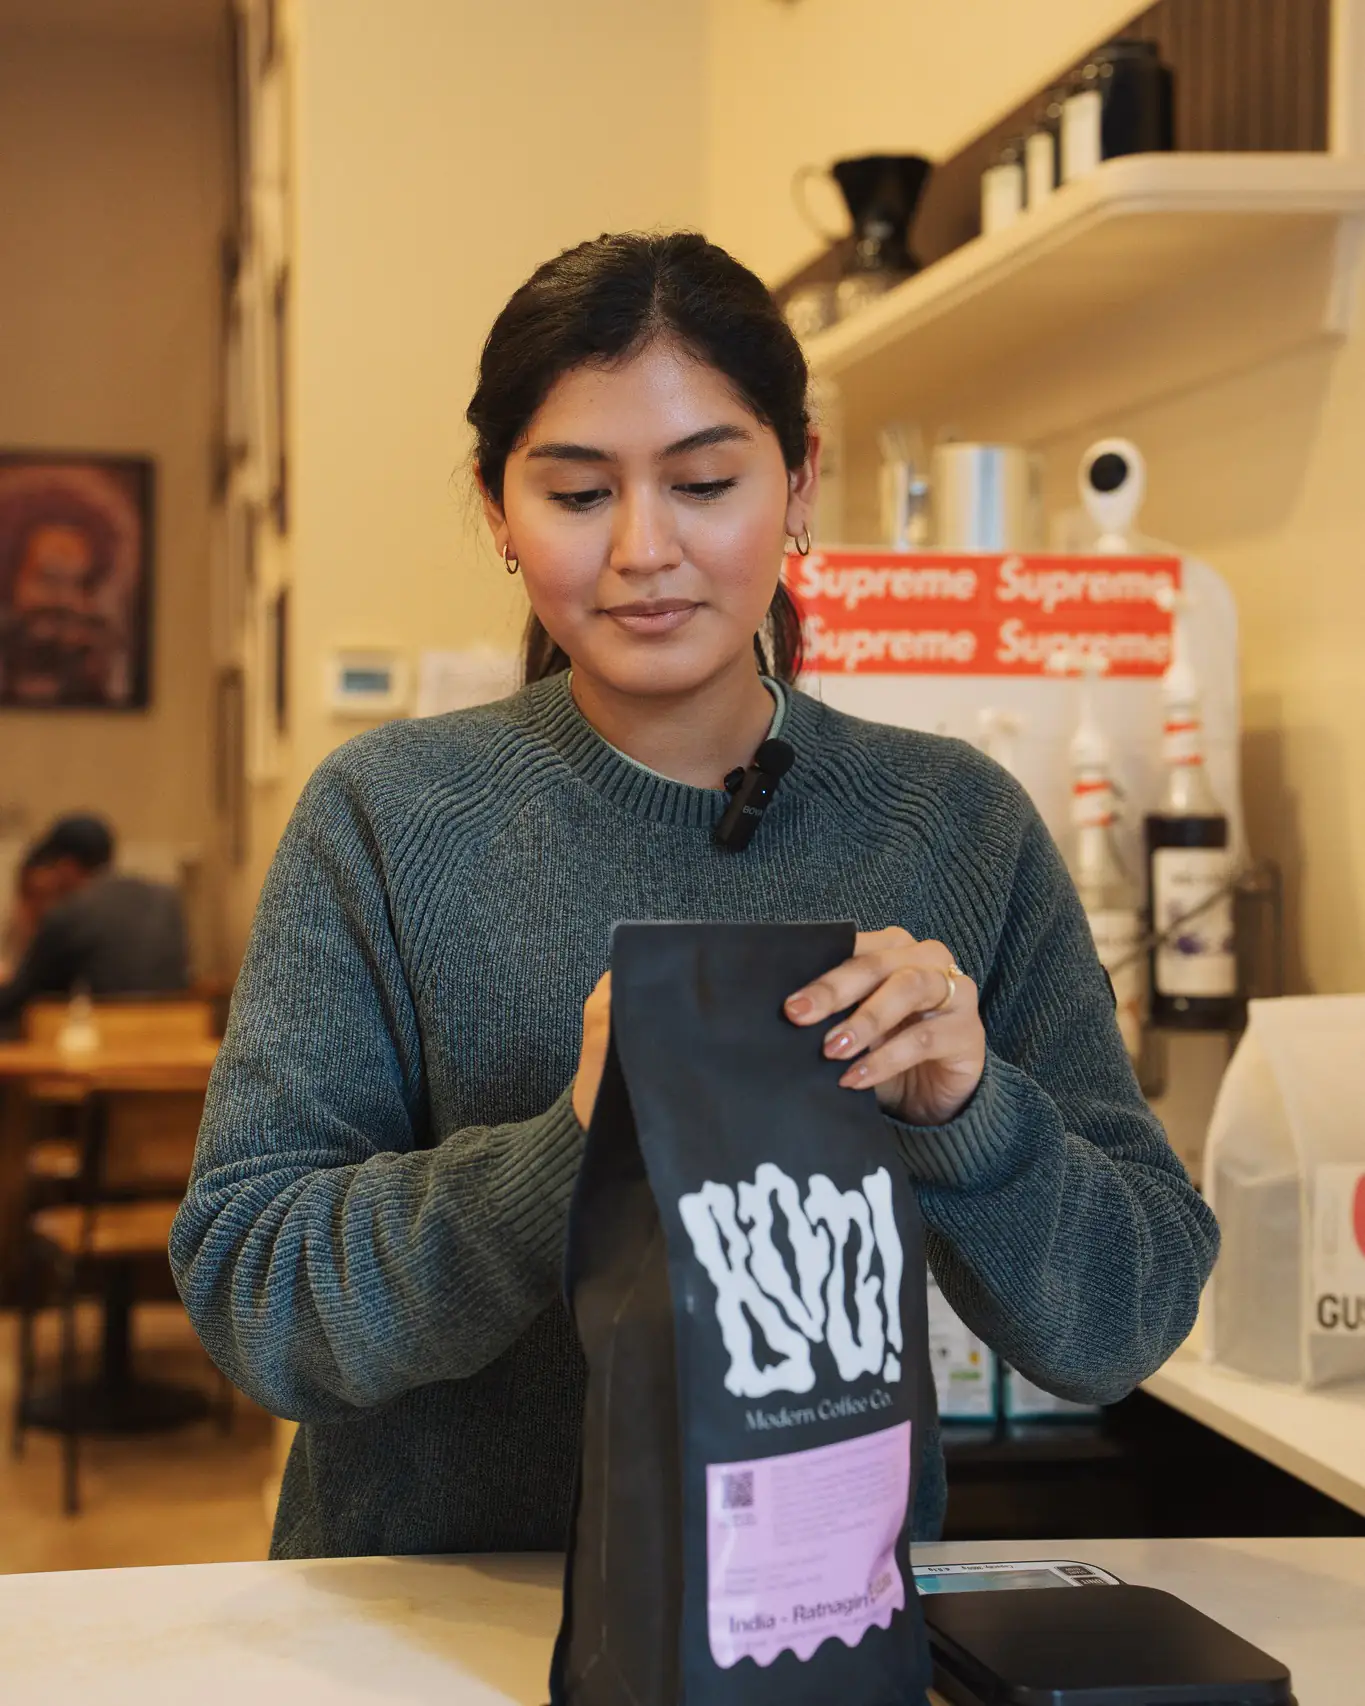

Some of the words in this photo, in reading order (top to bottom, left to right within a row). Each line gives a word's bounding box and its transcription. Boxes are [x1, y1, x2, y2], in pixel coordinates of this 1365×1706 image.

[799, 554, 976, 611] Supreme
[998, 552, 1176, 613] Supreme
[804, 614, 976, 673] Supreme
[1317, 1294, 1365, 1331] GU
[745, 1406, 816, 1431] Modern
[817, 1394, 868, 1421] Coffee
[729, 1611, 776, 1634] India
